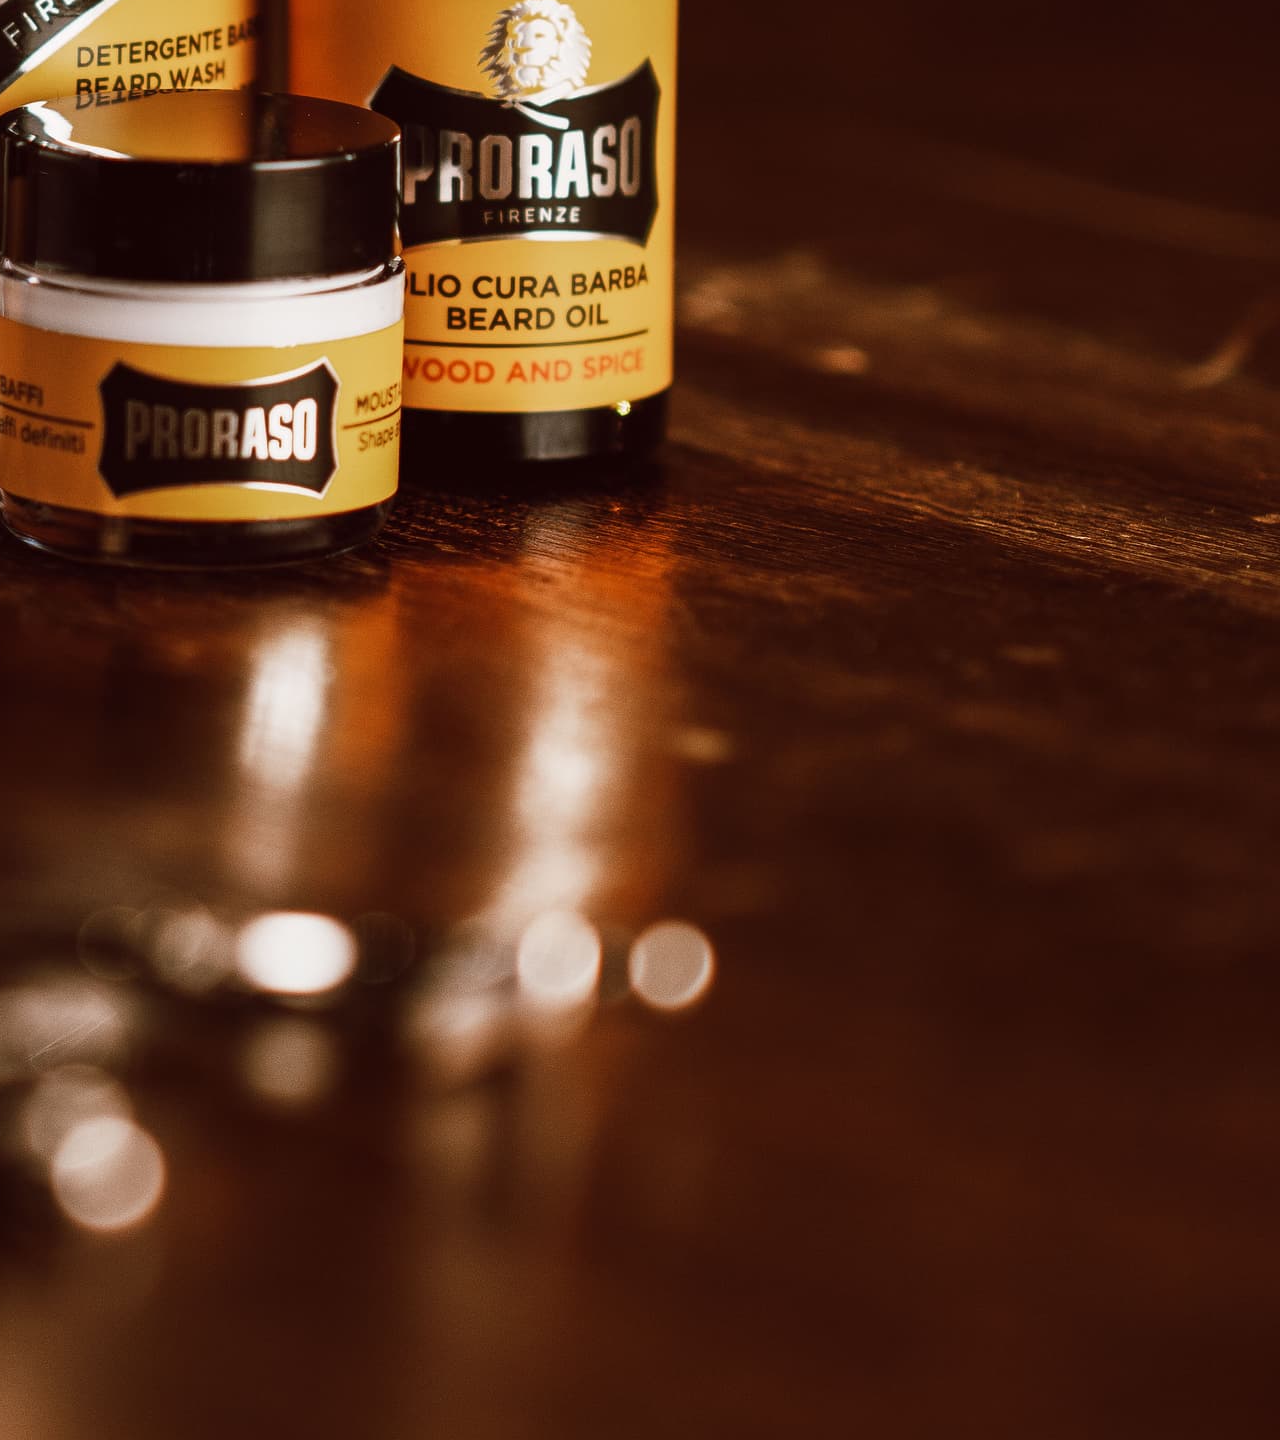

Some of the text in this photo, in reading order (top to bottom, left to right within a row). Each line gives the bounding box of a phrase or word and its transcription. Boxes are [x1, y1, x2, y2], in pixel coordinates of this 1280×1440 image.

[77, 28, 223, 68] DETERGENTE
[76, 60, 226, 96] BEARD WASH
[403, 116, 641, 205] PRORASO
[484, 206, 581, 224] FIRENZE
[405, 264, 648, 299] LIO CURA BARBA
[447, 303, 609, 331] BEARD OIL
[506, 359, 572, 384] AND
[584, 347, 645, 380] SPICE
[0, 374, 45, 406] BAFFI
[354, 383, 400, 415] MOUST
[126, 397, 317, 461] PRORASO
[357, 425, 394, 453] Shape
